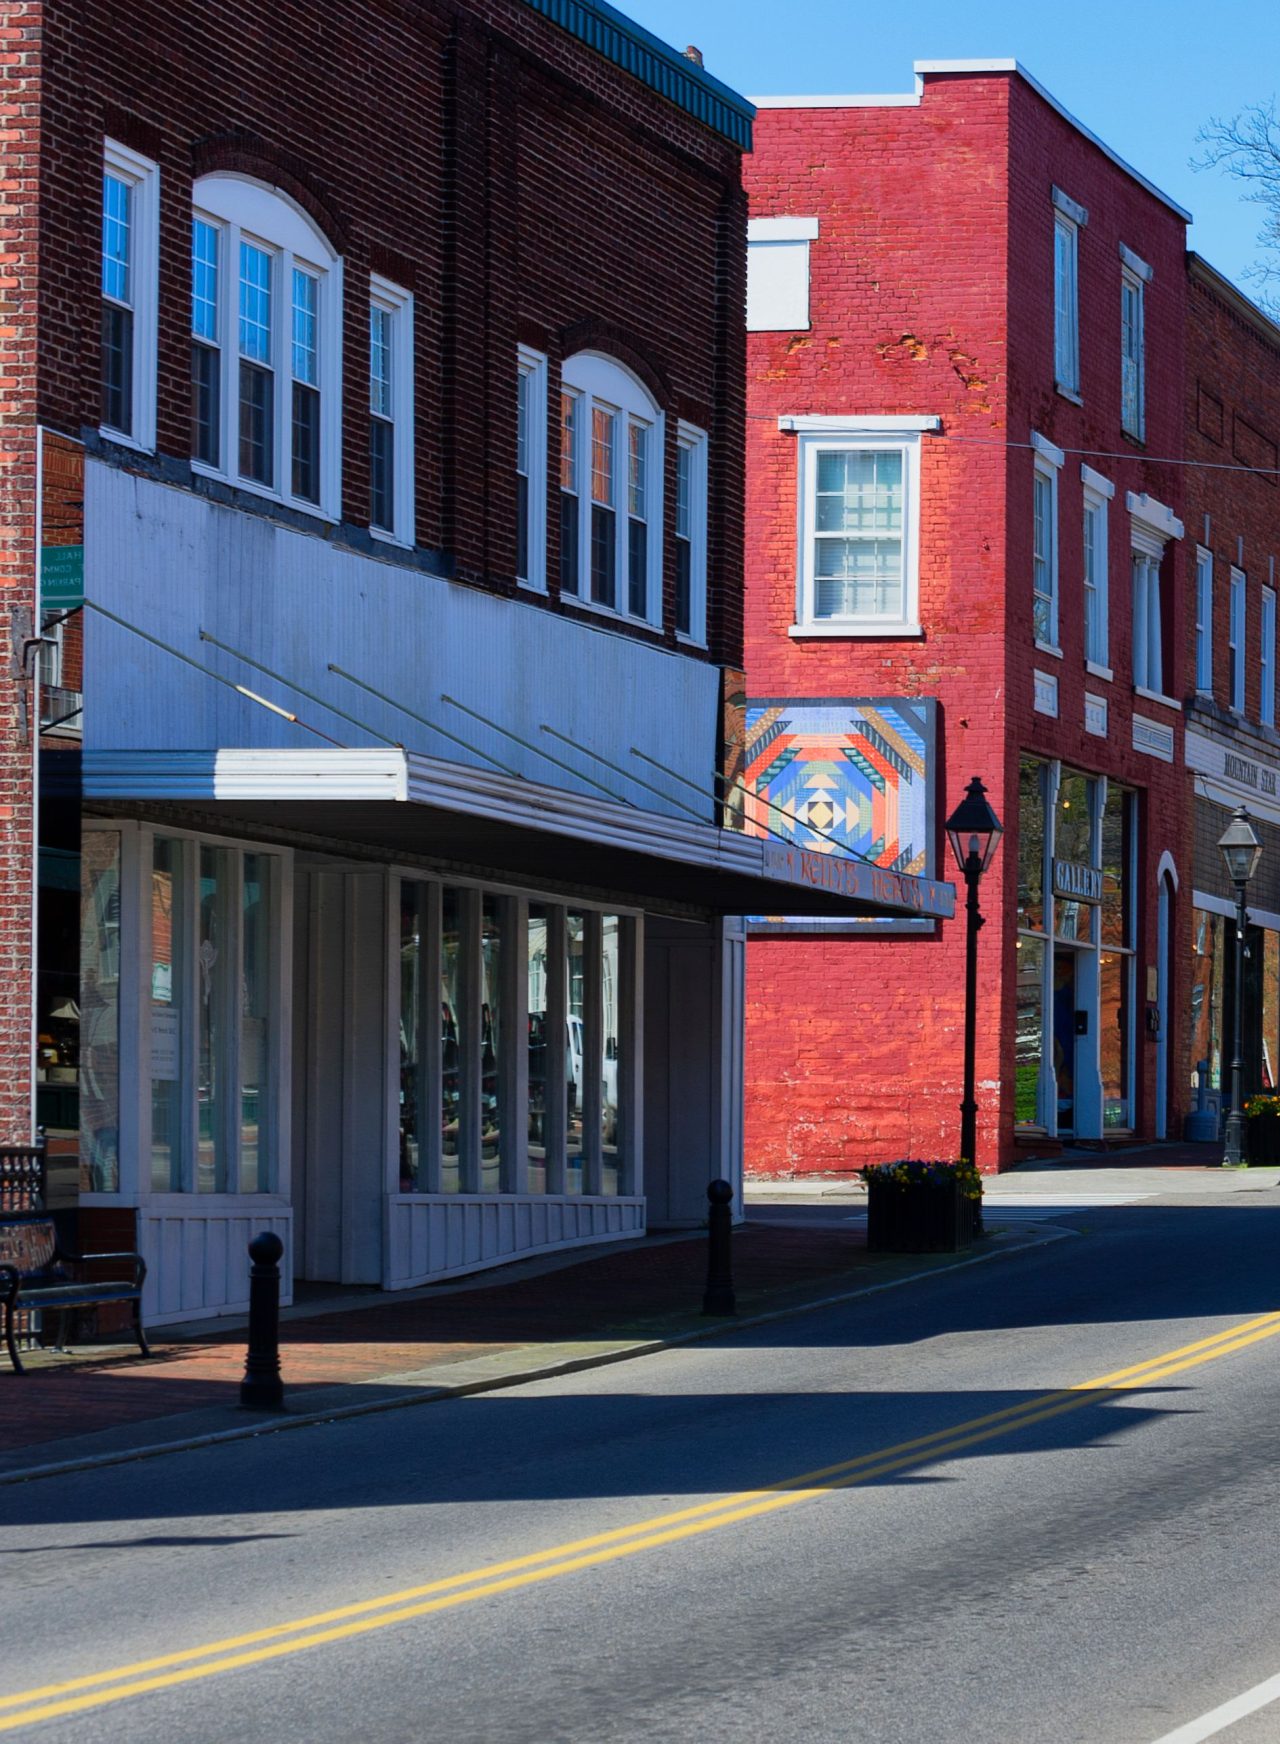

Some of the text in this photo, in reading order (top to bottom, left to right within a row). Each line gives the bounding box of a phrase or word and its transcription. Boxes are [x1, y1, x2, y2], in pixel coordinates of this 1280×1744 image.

[1224, 752, 1276, 796] MOUNTAIN STAR
[1056, 862, 1103, 900] GALLERY
